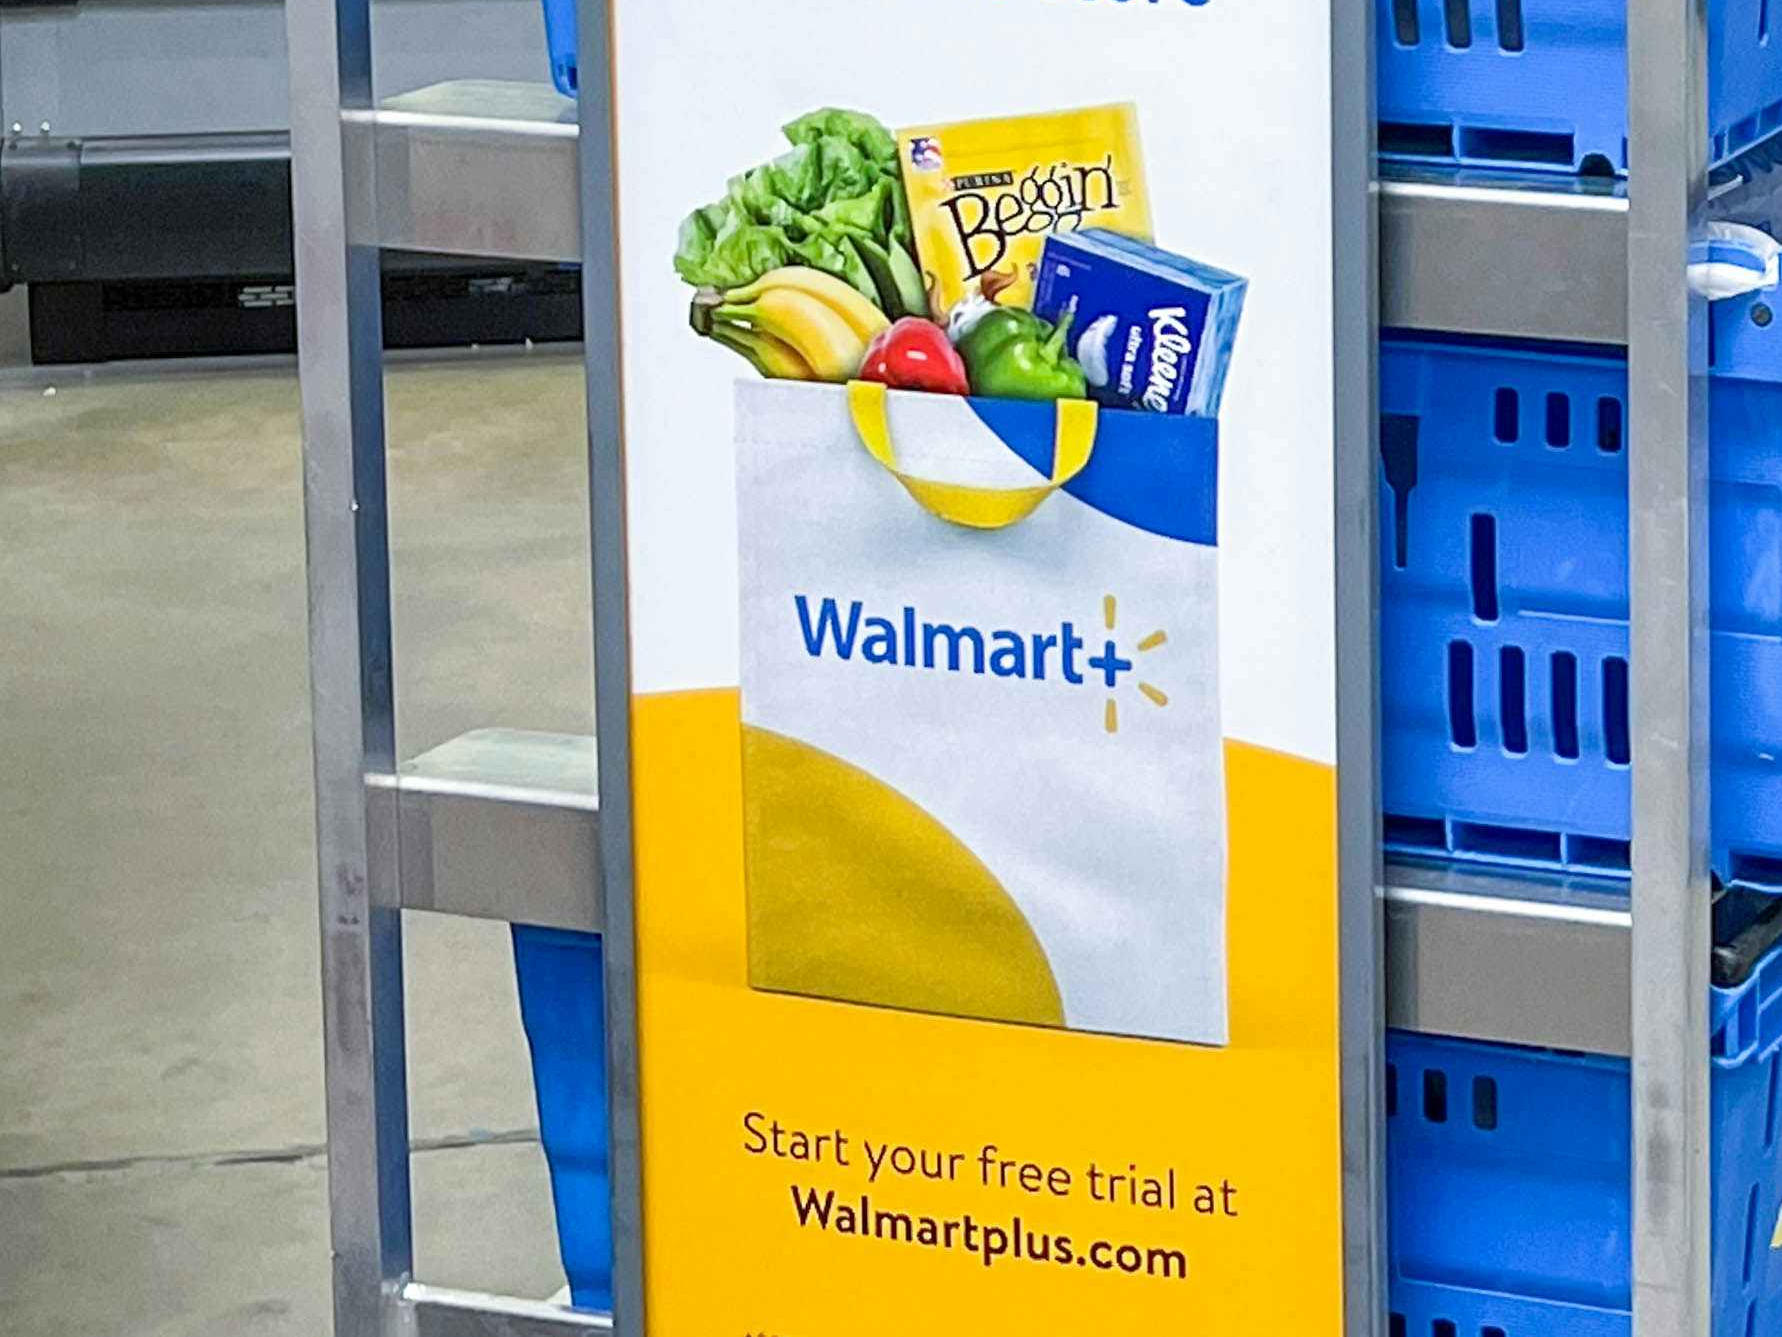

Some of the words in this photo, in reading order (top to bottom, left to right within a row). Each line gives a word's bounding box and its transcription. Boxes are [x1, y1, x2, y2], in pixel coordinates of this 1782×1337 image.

[1123, 325, 1143, 362] ultra
[794, 594, 1133, 689] Walmart+
[742, 1111, 849, 1167] Start
[864, 1140, 965, 1183] your
[977, 1145, 1073, 1196] free
[1086, 1162, 1177, 1211] trial
[1193, 1176, 1240, 1218] at
[790, 1184, 1189, 1280] Walmartplus.com
